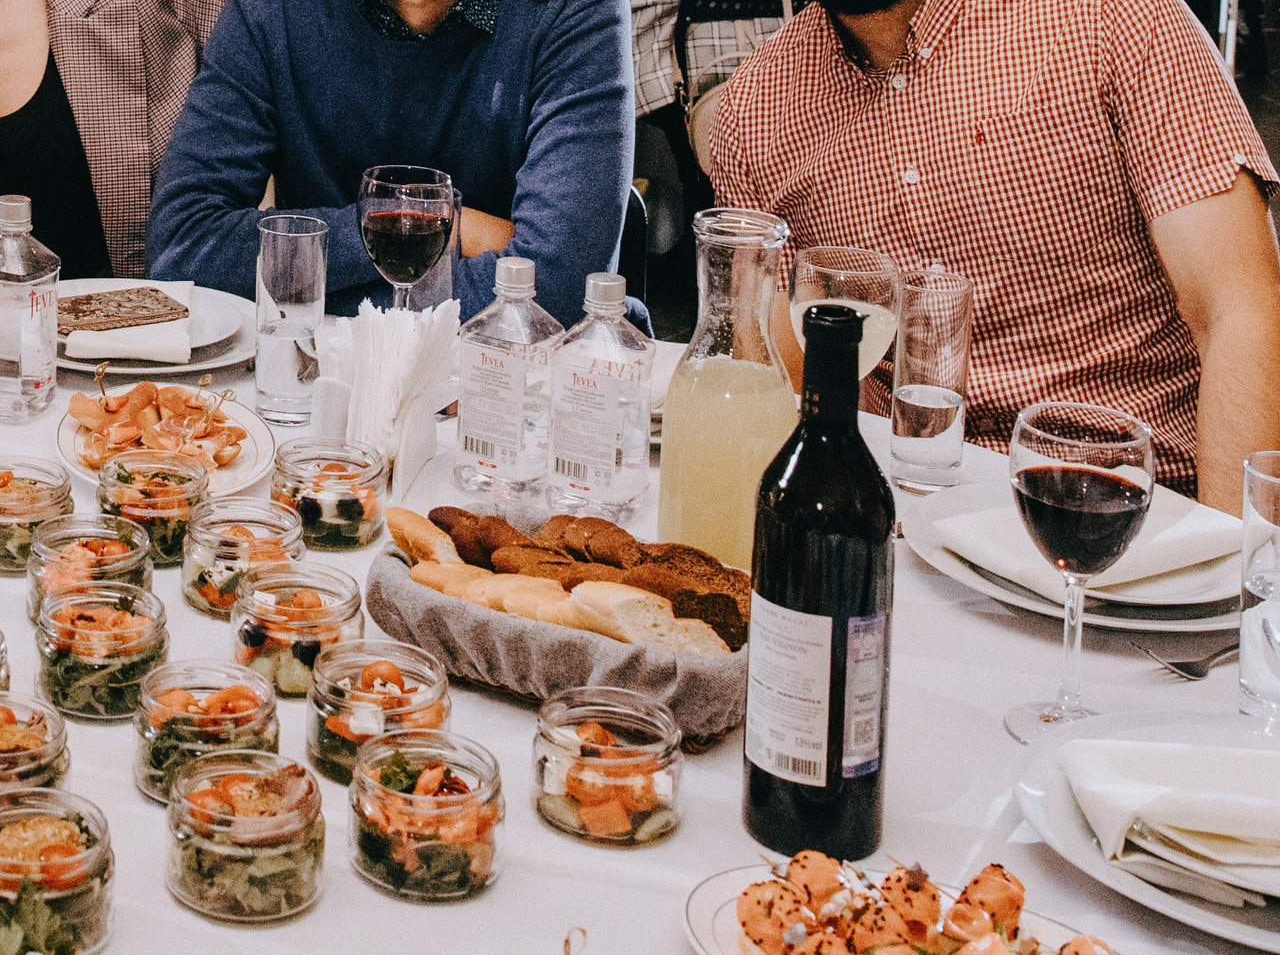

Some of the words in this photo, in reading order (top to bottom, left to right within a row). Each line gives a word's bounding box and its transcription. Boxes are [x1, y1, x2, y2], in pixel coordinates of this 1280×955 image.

[28, 290, 58, 320] JEVE
[481, 352, 504, 369] JEVEA
[572, 372, 598, 389] JEVEA
